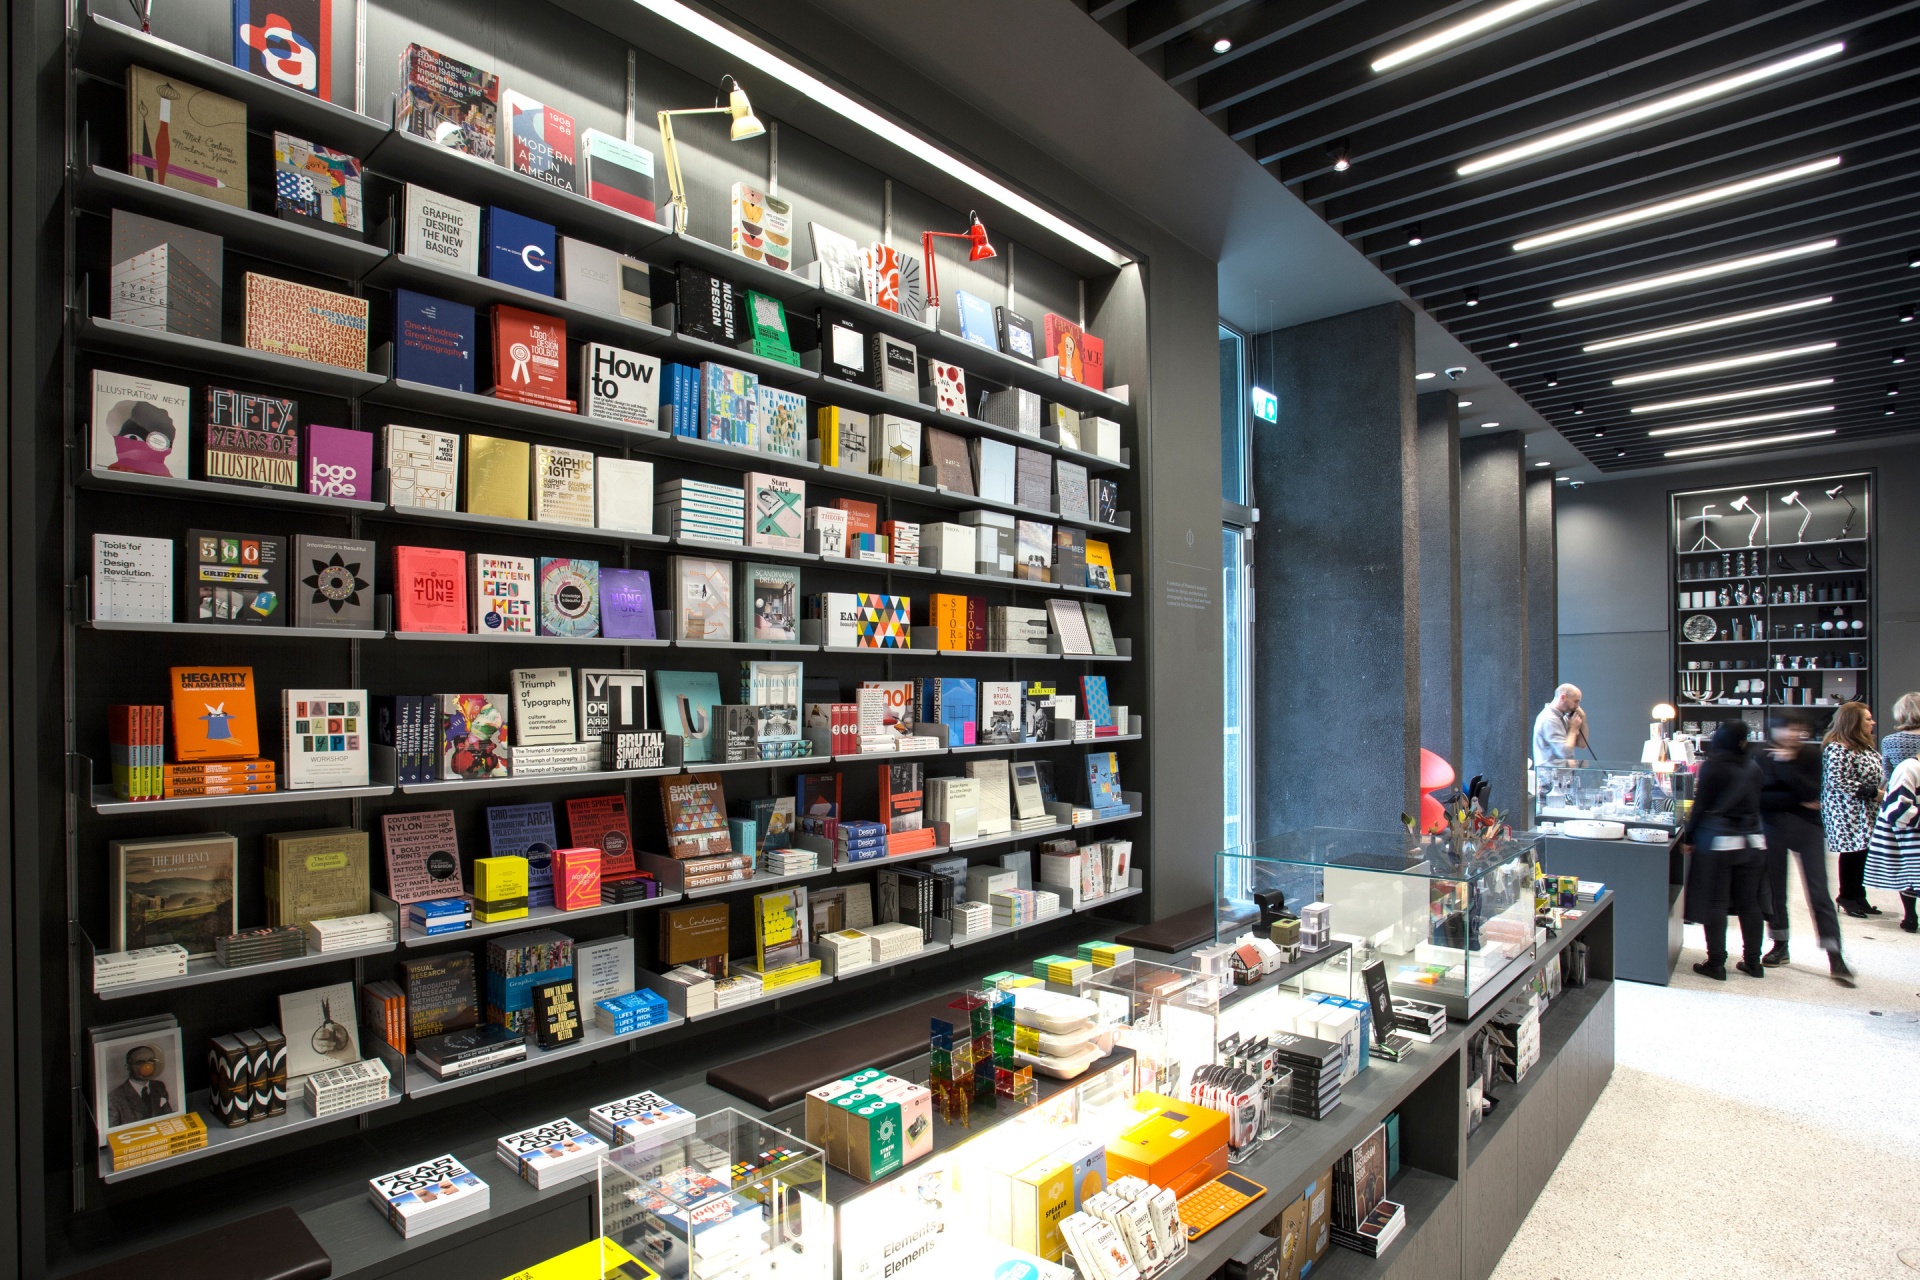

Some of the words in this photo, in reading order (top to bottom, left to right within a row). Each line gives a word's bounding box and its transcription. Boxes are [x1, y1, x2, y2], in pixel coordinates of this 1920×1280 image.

[183, 129, 234, 154] Mid-Century
[518, 134, 573, 166] MODERN
[519, 150, 544, 166] ART
[547, 160, 560, 174] IN
[519, 163, 573, 192] AMERICA
[422, 205, 464, 227] GRAPHIC
[425, 217, 460, 236] DESIGN
[421, 228, 441, 242] THE
[443, 234, 463, 248] NEW
[425, 239, 459, 258] BASICS
[710, 277, 722, 328] DESIGN
[722, 282, 735, 340] MUSEUM
[531, 345, 559, 359] TOOLBOX
[594, 347, 653, 384] How
[872, 337, 883, 392] CONCRETE
[591, 376, 619, 399] to
[97, 384, 158, 402] ILLUSTRATION
[162, 397, 186, 407] NEXT
[778, 393, 804, 407] WORKS
[213, 390, 293, 434] FIFTY
[212, 427, 268, 451] YEARS
[271, 436, 293, 454] OF
[440, 437, 454, 445] NICE
[438, 446, 454, 454] MEET
[435, 455, 453, 463] AGAIN
[210, 451, 293, 486] ILLUSTRATION
[313, 456, 357, 484] logo
[709, 484, 733, 493] INTERACTIONS
[771, 478, 788, 488] Start
[709, 495, 732, 503] INTERACTIONS
[821, 513, 845, 522] THEORY
[103, 558, 136, 569] Design
[483, 559, 513, 570] PRINT
[517, 562, 524, 571] &
[103, 567, 152, 577] Revolution
[483, 569, 531, 584] PATTERN
[755, 569, 794, 580] SCANDINAVIA
[759, 577, 791, 585] DREAMING
[181, 673, 247, 683] HEGARTY
[519, 672, 536, 680] The
[520, 680, 556, 689] Triumph
[521, 690, 531, 698] of
[522, 698, 571, 711] Typography
[428, 707, 436, 752] TYPOGRAPHIC
[617, 732, 665, 748] BRUTAL
[728, 734, 750, 743] Language
[728, 754, 743, 762] Sudjic
[569, 800, 590, 810] WHITE
[591, 798, 611, 808] SPACE
[577, 813, 601, 821] DYNAMIC
[388, 822, 422, 832] NYLON
[858, 828, 877, 838] Design
[403, 835, 420, 843] NEW
[420, 833, 439, 841] LOOK
[858, 839, 877, 849] Design
[858, 850, 878, 861] Design
[689, 863, 725, 874] SHIGERU
[726, 860, 743, 869] BAN
[409, 879, 430, 887] PANTS
[690, 876, 726, 887] SHIGERU
[727, 872, 743, 882] BAN
[412, 886, 461, 898] SUPERMODEL
[409, 964, 434, 974] VISUAL
[410, 968, 446, 980] RESEARCH
[411, 978, 460, 992] INTRODUCTION
[411, 991, 422, 999] TO
[423, 985, 457, 998] RESEARCH
[543, 987, 555, 999] HOW
[554, 985, 561, 995] TO
[560, 982, 573, 995] MAKE
[411, 993, 446, 1005] METHODS
[412, 1011, 423, 1019] IAN
[424, 1007, 448, 1017] NOBLE
[413, 1021, 443, 1032] RUSSELL
[413, 1026, 443, 1039] BESTLEY
[597, 1093, 655, 1114] FEAR
[610, 1098, 657, 1117] AND
[610, 1100, 668, 1121] LOVE
[505, 1120, 570, 1145] FEAR
[519, 1125, 569, 1149] AND
[128, 1146, 141, 1154] RULES
[147, 1139, 168, 1148] CREATIVITY
[170, 1134, 187, 1142] MICHAEL
[517, 1127, 584, 1154] LOVE
[880, 1144, 895, 1156] SYNTH
[883, 1151, 892, 1160] KIT
[1354, 1146, 1363, 1159] THE
[1355, 1145, 1376, 1173] INSTAGRAM
[377, 1156, 455, 1187] FEAR
[390, 1164, 450, 1192] AND
[1356, 1168, 1367, 1183] BOOK
[388, 1167, 466, 1197] LOVE
[1045, 1199, 1068, 1219] SPEAKER
[1161, 1201, 1177, 1216] CORKERS
[1052, 1211, 1061, 1222] KIT
[1134, 1212, 1149, 1228] CORKERS
[883, 1221, 936, 1258] Elements
[1097, 1230, 1115, 1245] CORKERS
[884, 1239, 935, 1279] Elements
[1253, 1259, 1263, 1272] 20th
[1262, 1246, 1278, 1266] Century
